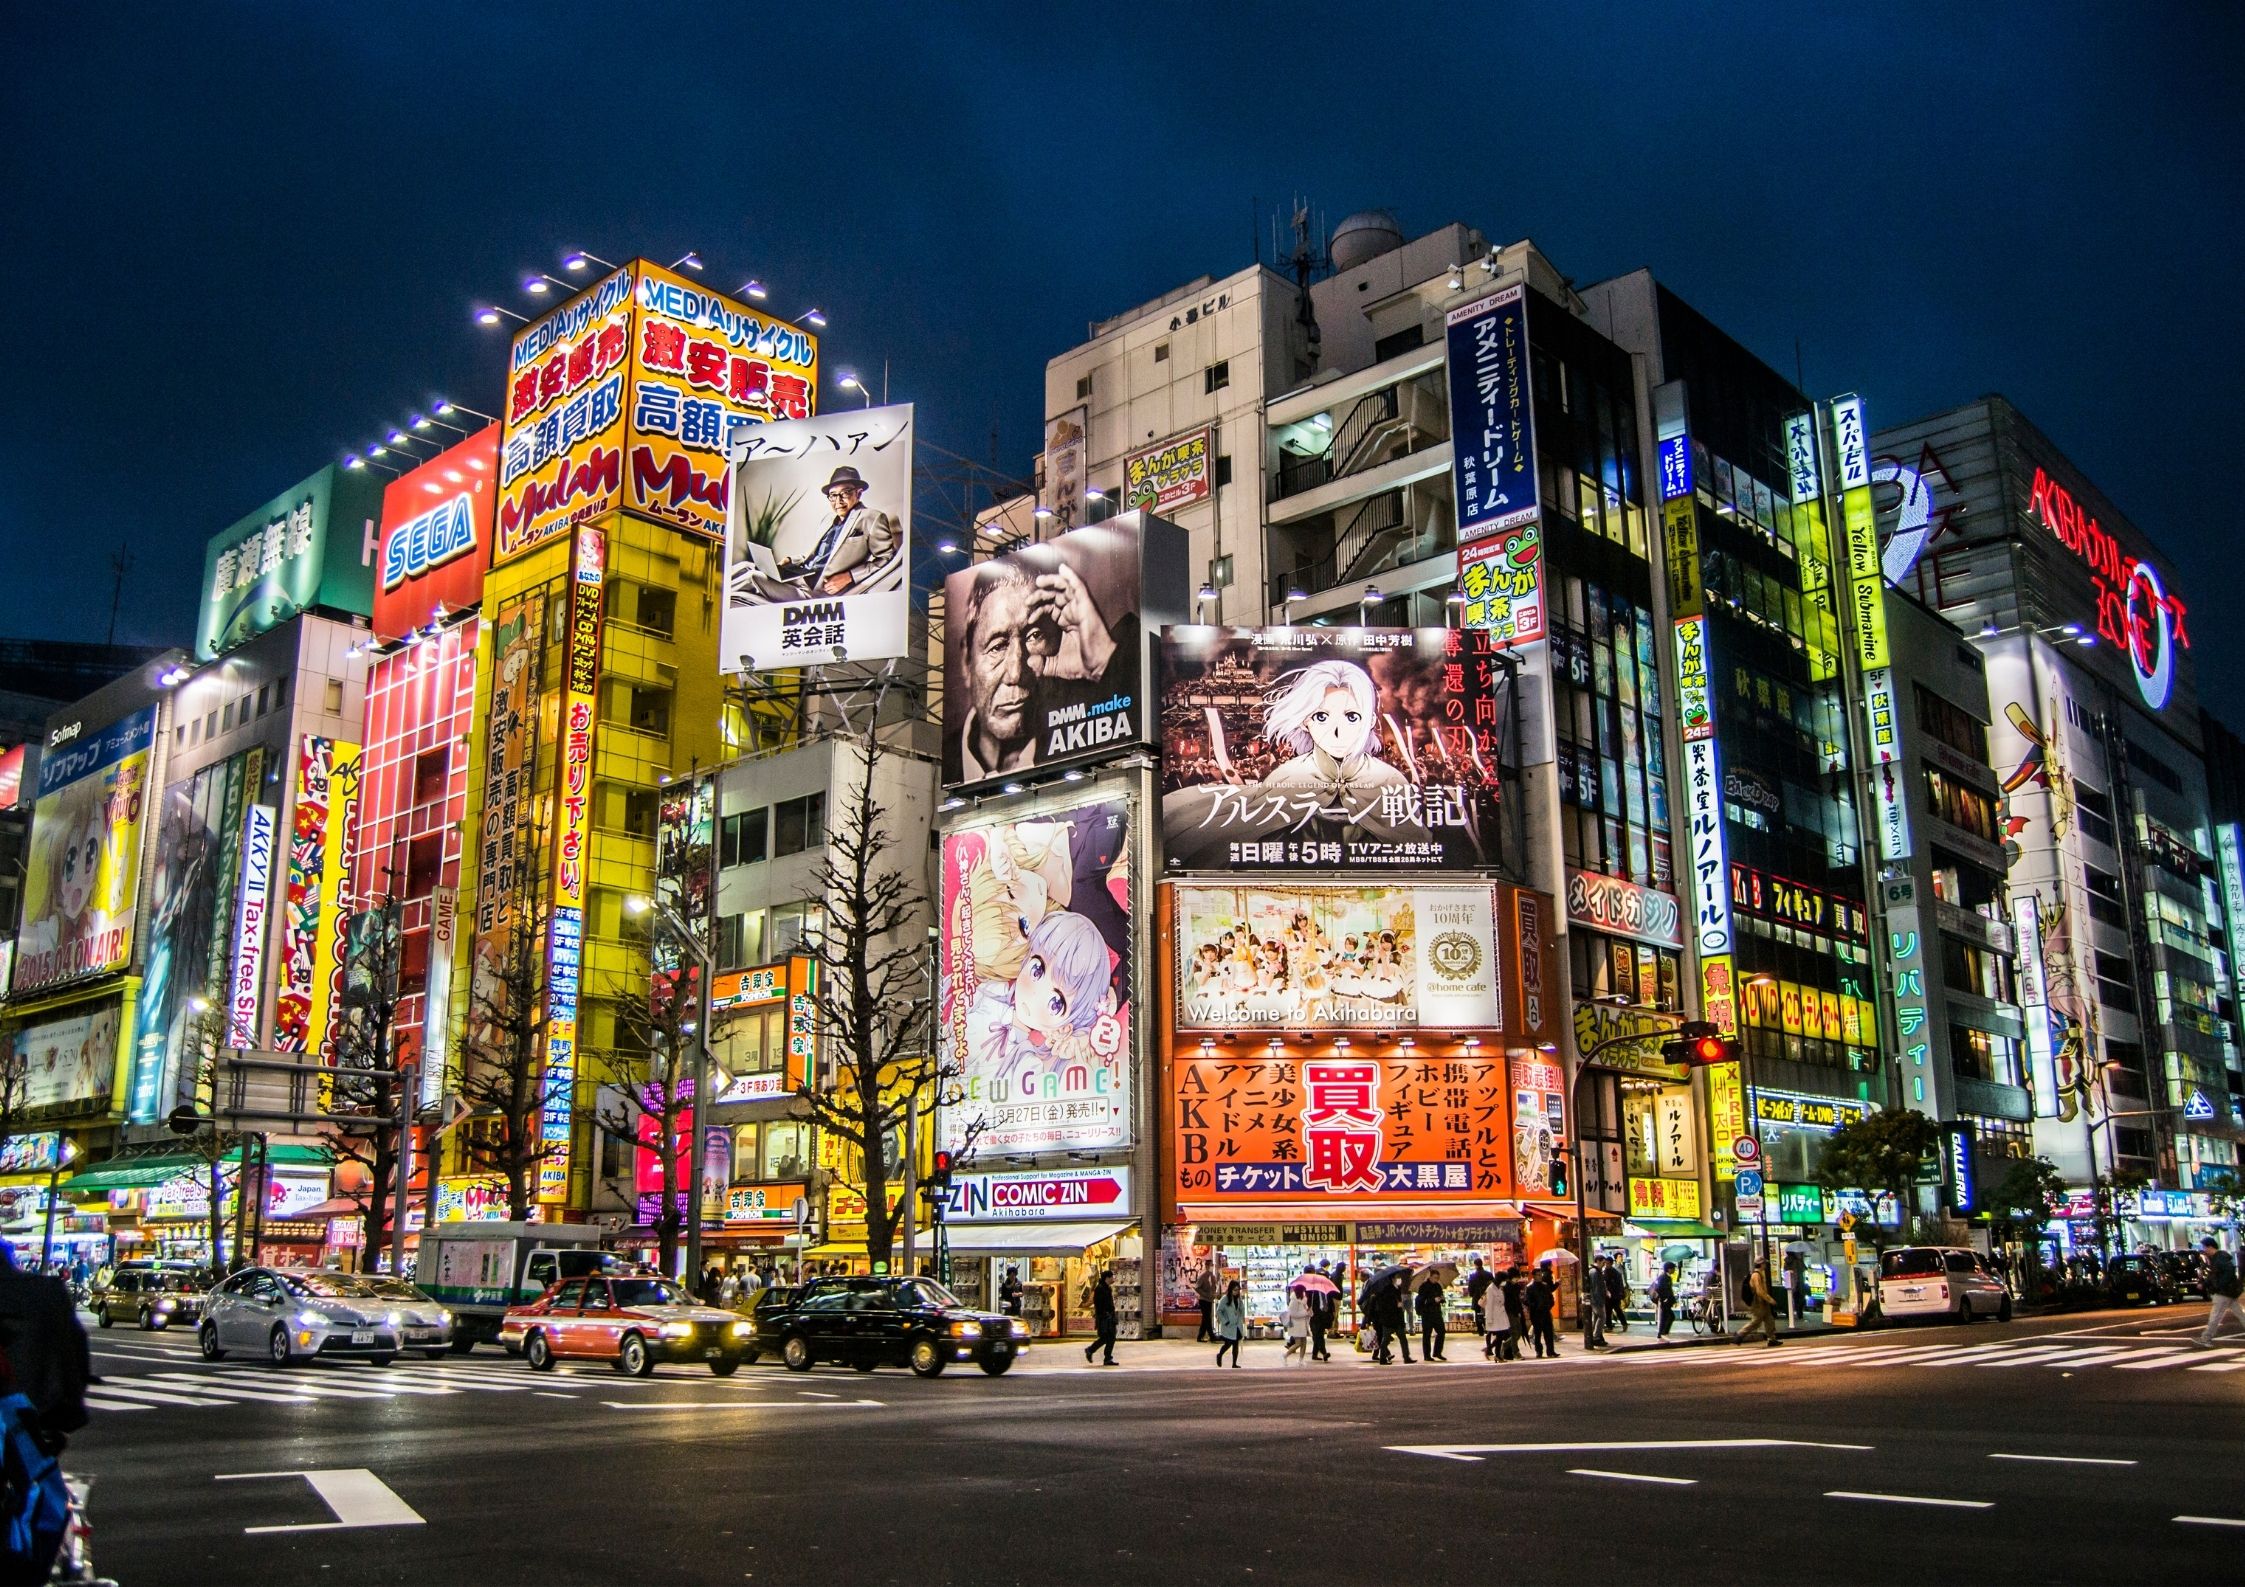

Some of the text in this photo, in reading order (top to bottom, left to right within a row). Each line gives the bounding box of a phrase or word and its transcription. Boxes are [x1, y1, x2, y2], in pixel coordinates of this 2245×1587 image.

[1451, 289, 1518, 322] AMENITY DREAM
[510, 316, 628, 422] 激安販売
[640, 319, 809, 419] 激安販売
[1473, 316, 1509, 510] アメニティードリーム
[503, 374, 622, 487] 高額買取
[1839, 407, 1864, 481] スーパービル
[1129, 437, 1206, 485] まんが喫茶
[1464, 456, 1479, 517] 秋葉原店
[543, 517, 569, 537] AKIBA
[648, 499, 703, 526] ムーラン
[1464, 511, 1533, 539] AMENITY DREAM
[383, 492, 477, 589] SEGA
[578, 585, 599, 599] DVD
[1463, 561, 1537, 601] まんが
[1850, 525, 1879, 661] Yellow Submarine
[577, 608, 598, 622] ゲーム
[578, 621, 593, 633] CD
[782, 602, 846, 627] DMM
[1465, 595, 1512, 627] 喫茶
[1518, 618, 1537, 631] 3F
[782, 623, 845, 649] 英会話
[1363, 633, 1414, 646] 田中芳樹
[1680, 620, 1702, 676] まんが
[1571, 656, 1590, 684] 6F
[1870, 670, 1885, 682] 5F
[51, 721, 82, 747] Sofmap
[1047, 711, 1132, 756] AKIBA
[44, 738, 101, 787] ソフマップ
[1692, 744, 1711, 811] 喫茶室
[1298, 781, 1328, 789] LEGEND
[1578, 775, 1597, 802] 5F
[1198, 783, 1467, 834] アルスラーン戦記
[249, 808, 271, 879] AKKY
[1242, 841, 1443, 863] 日曜 5時 TVアニメ放送中
[1690, 813, 1726, 926] ルノアール
[436, 894, 453, 942] GAME
[1429, 903, 1476, 912] おかげさまで
[1434, 912, 1474, 925] 10周年
[1569, 874, 1678, 938] メイドカジノ
[239, 898, 265, 993] Tax-free
[739, 970, 774, 991] 吉野家
[1427, 982, 1487, 992] @home cafe
[792, 995, 806, 1056] 吉野家
[1187, 1002, 1418, 1024] Welcome to Akihabara
[1891, 930, 1927, 1101] リバティー
[1214, 1064, 1241, 1158] アイドル
[1242, 1064, 1269, 1133] アニメ
[1270, 1062, 1298, 1160] 美少女系
[1387, 1063, 1414, 1160] フィギュア
[1415, 1063, 1440, 1132] ホビー
[1443, 1062, 1472, 1159] 携帯電話
[1303, 1060, 1387, 1193] 買取
[1472, 1064, 1502, 1190] アップルとか
[1669, 1109, 1685, 1167] ルノアール
[1738, 1142, 1754, 1155] 40
[542, 1170, 566, 1181] AKIBA
[1218, 1164, 1468, 1190] チケット 大黒屋
[1740, 1176, 1752, 1192] P
[1951, 1131, 1967, 1208] GALLERIA
[731, 1189, 765, 1208] 吉野家
[993, 1181, 1088, 1205] COMIC ZIN
[1634, 1180, 1666, 1208] 免税
[1781, 1193, 1820, 1212] リバティー
[992, 1207, 1045, 1217] Akihabara
[1230, 1226, 1275, 1235] TRANSFER
[1283, 1224, 1337, 1235] WESTERN
[1299, 1233, 1337, 1242] UNION
